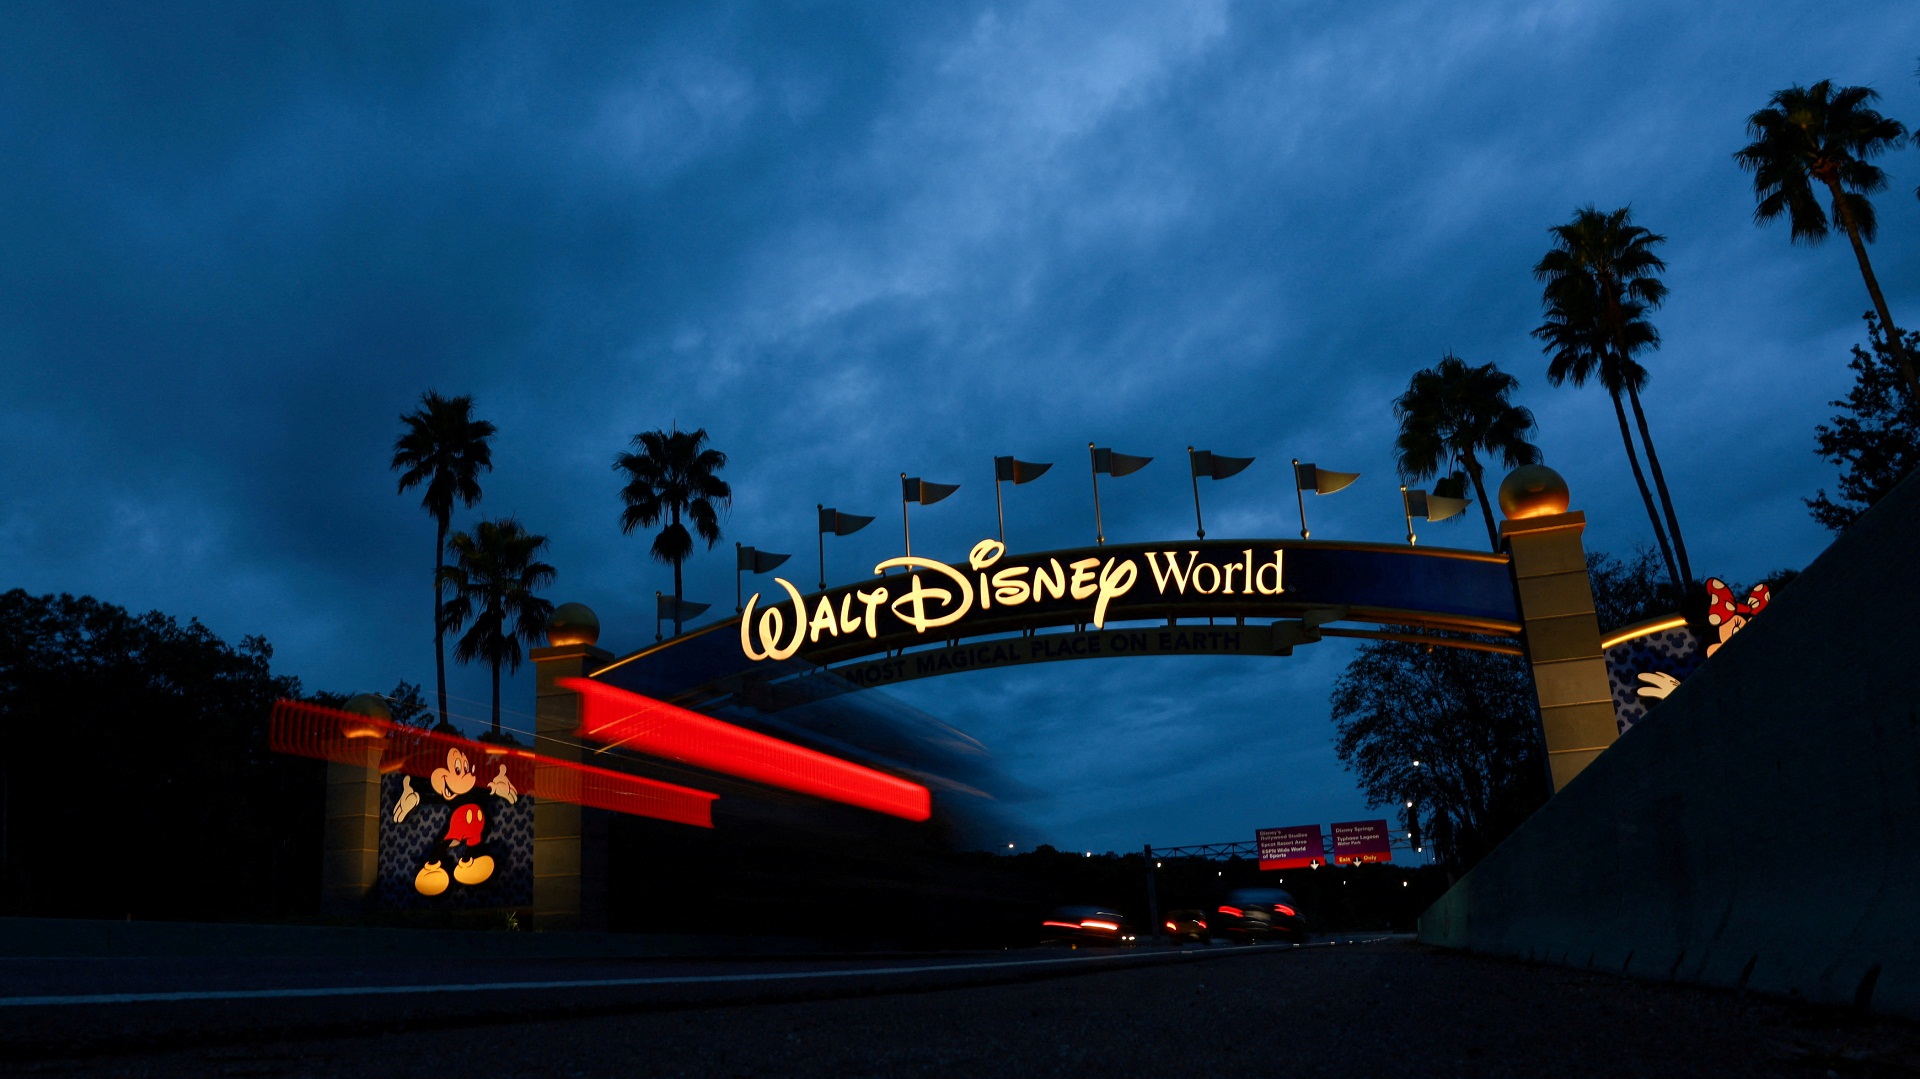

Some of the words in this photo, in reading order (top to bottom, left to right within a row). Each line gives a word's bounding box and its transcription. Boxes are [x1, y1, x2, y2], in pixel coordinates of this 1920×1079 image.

[1144, 549, 1286, 596] World
[840, 661, 905, 686] MOST
[916, 644, 1020, 675] MAGICAL
[1030, 632, 1101, 658] PLACE
[1110, 632, 1148, 653] ON
[1159, 631, 1241, 652] EARTH
